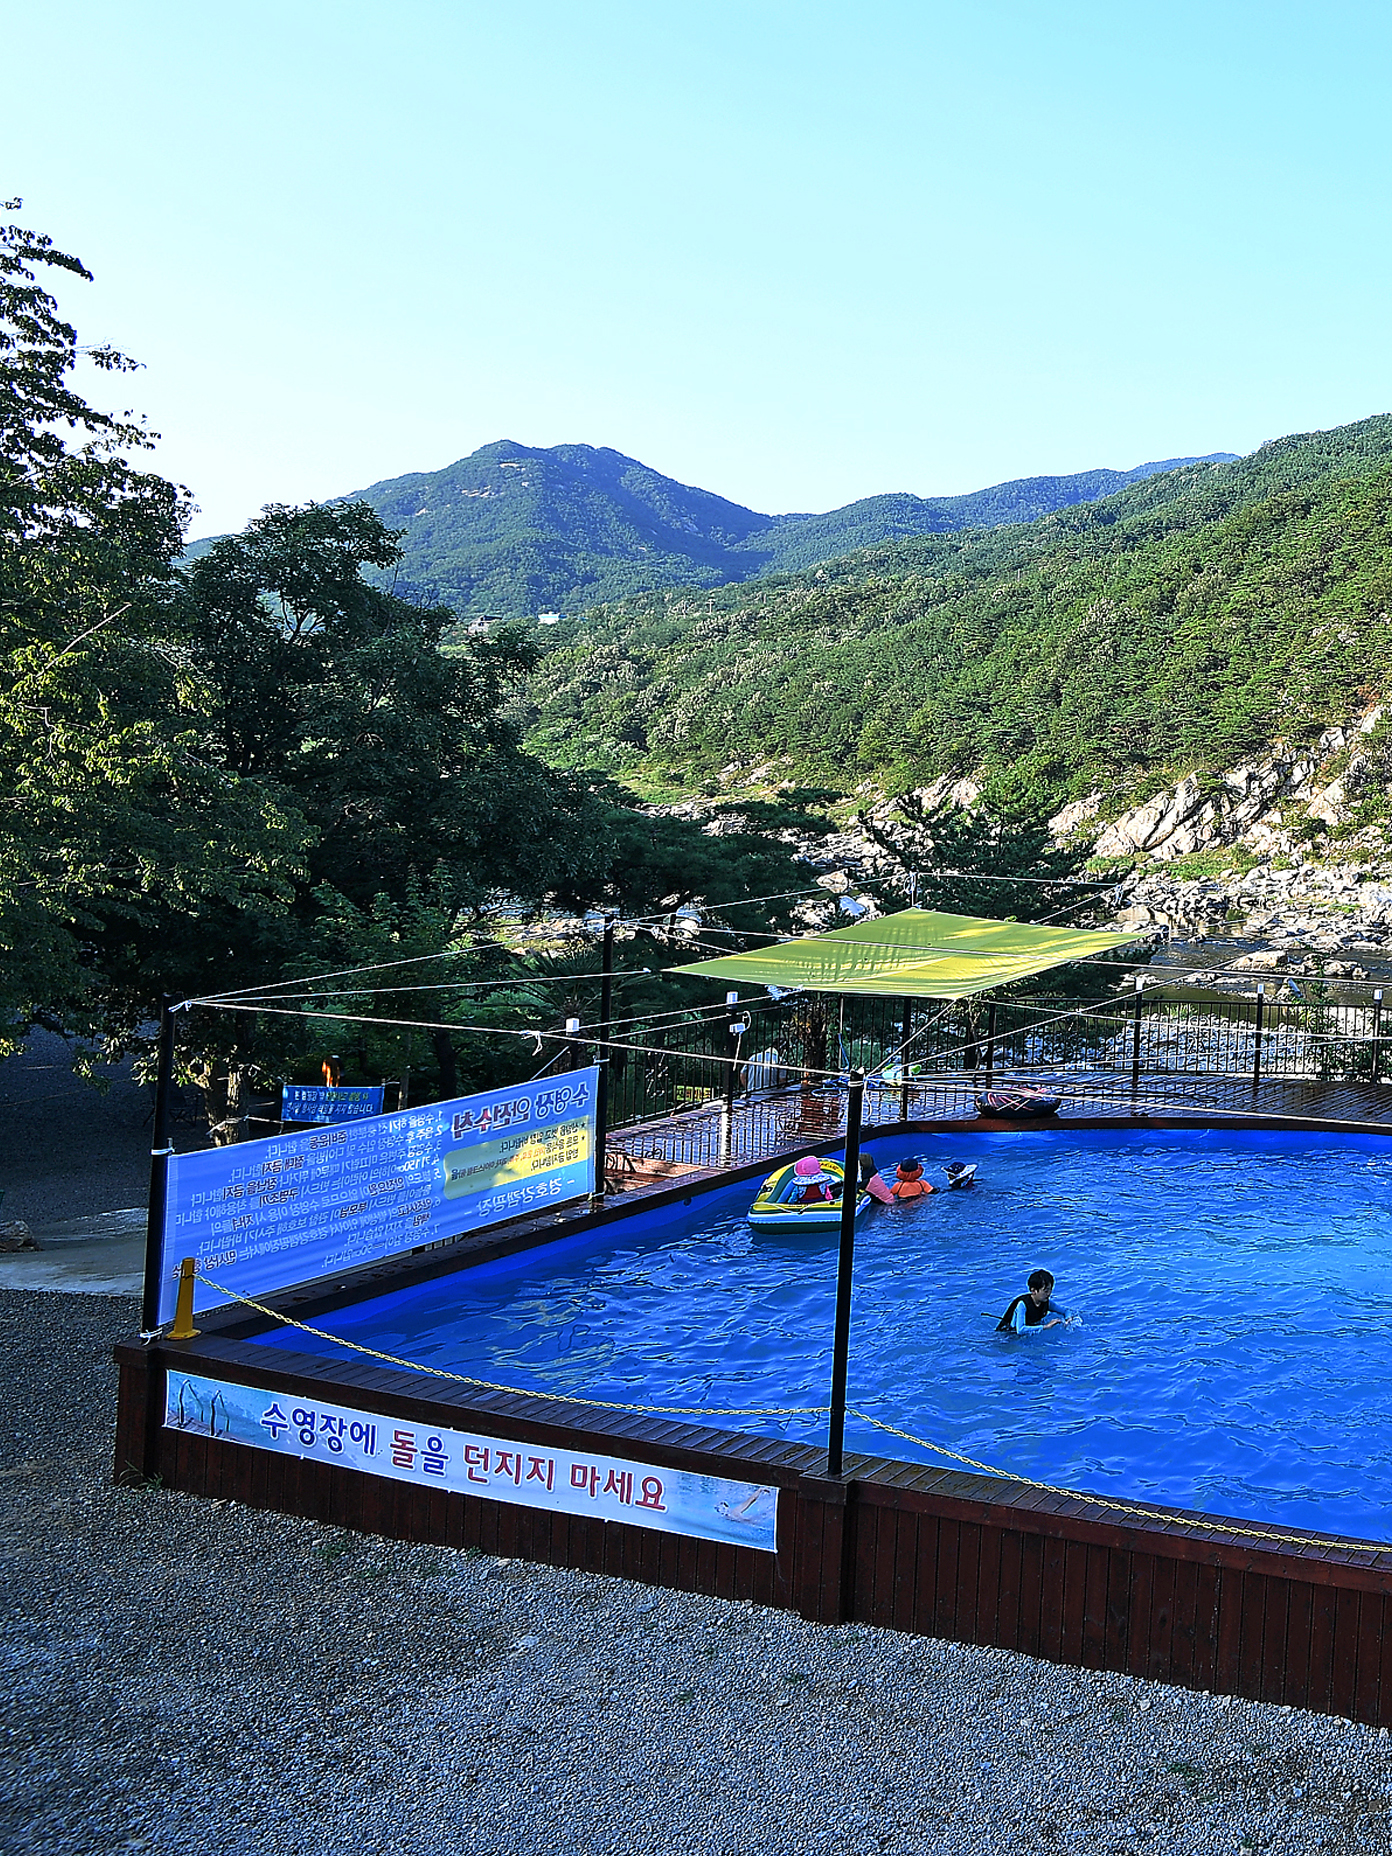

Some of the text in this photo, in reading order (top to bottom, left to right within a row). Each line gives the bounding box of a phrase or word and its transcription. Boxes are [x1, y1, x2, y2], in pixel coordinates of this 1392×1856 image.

[260, 1400, 667, 1512] 수영장에 돌을 던지지 마세요
